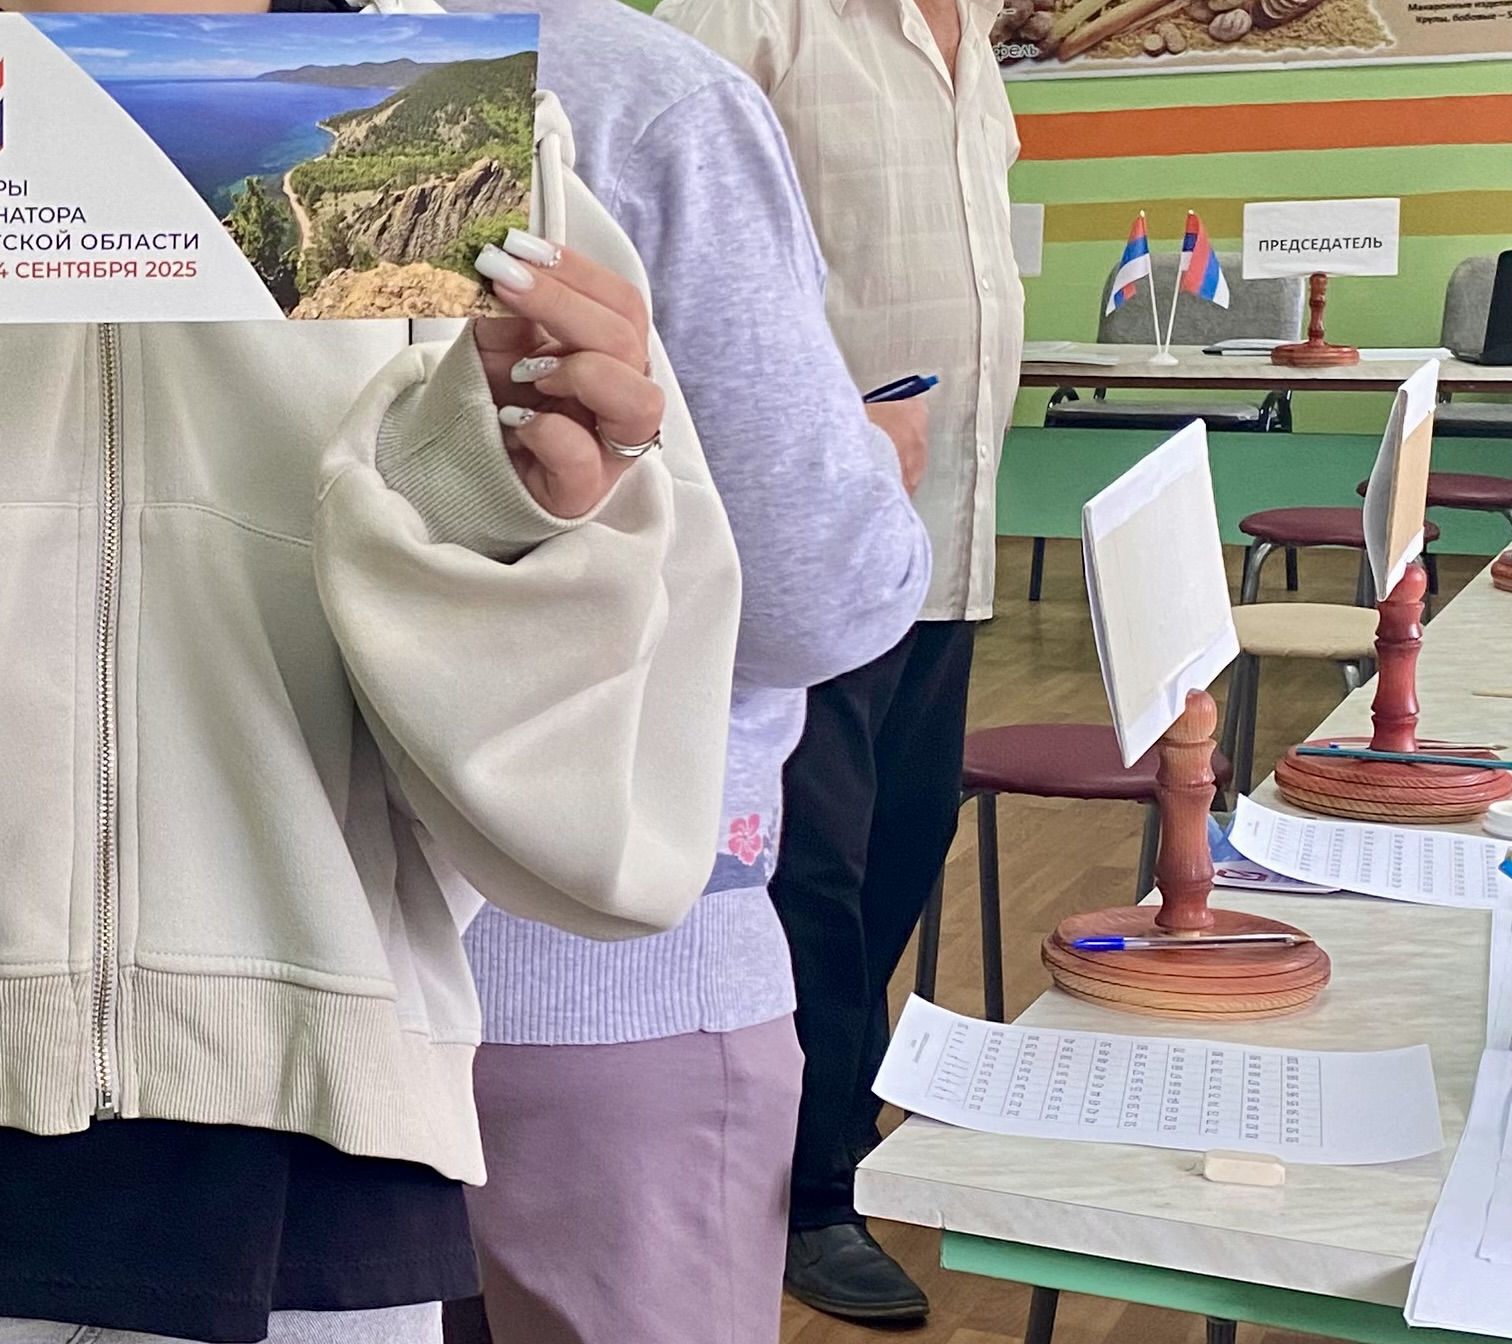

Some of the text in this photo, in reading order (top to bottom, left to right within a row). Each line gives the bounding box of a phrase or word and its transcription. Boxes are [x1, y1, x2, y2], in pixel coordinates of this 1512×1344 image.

[81, 233, 199, 250] ОБЛАСТИ
[1259, 237, 1383, 253] ПРЕДСЕДАТЕЛЬ
[15, 261, 138, 279] СЕНТЯБРЯ
[145, 260, 197, 278] 2025
